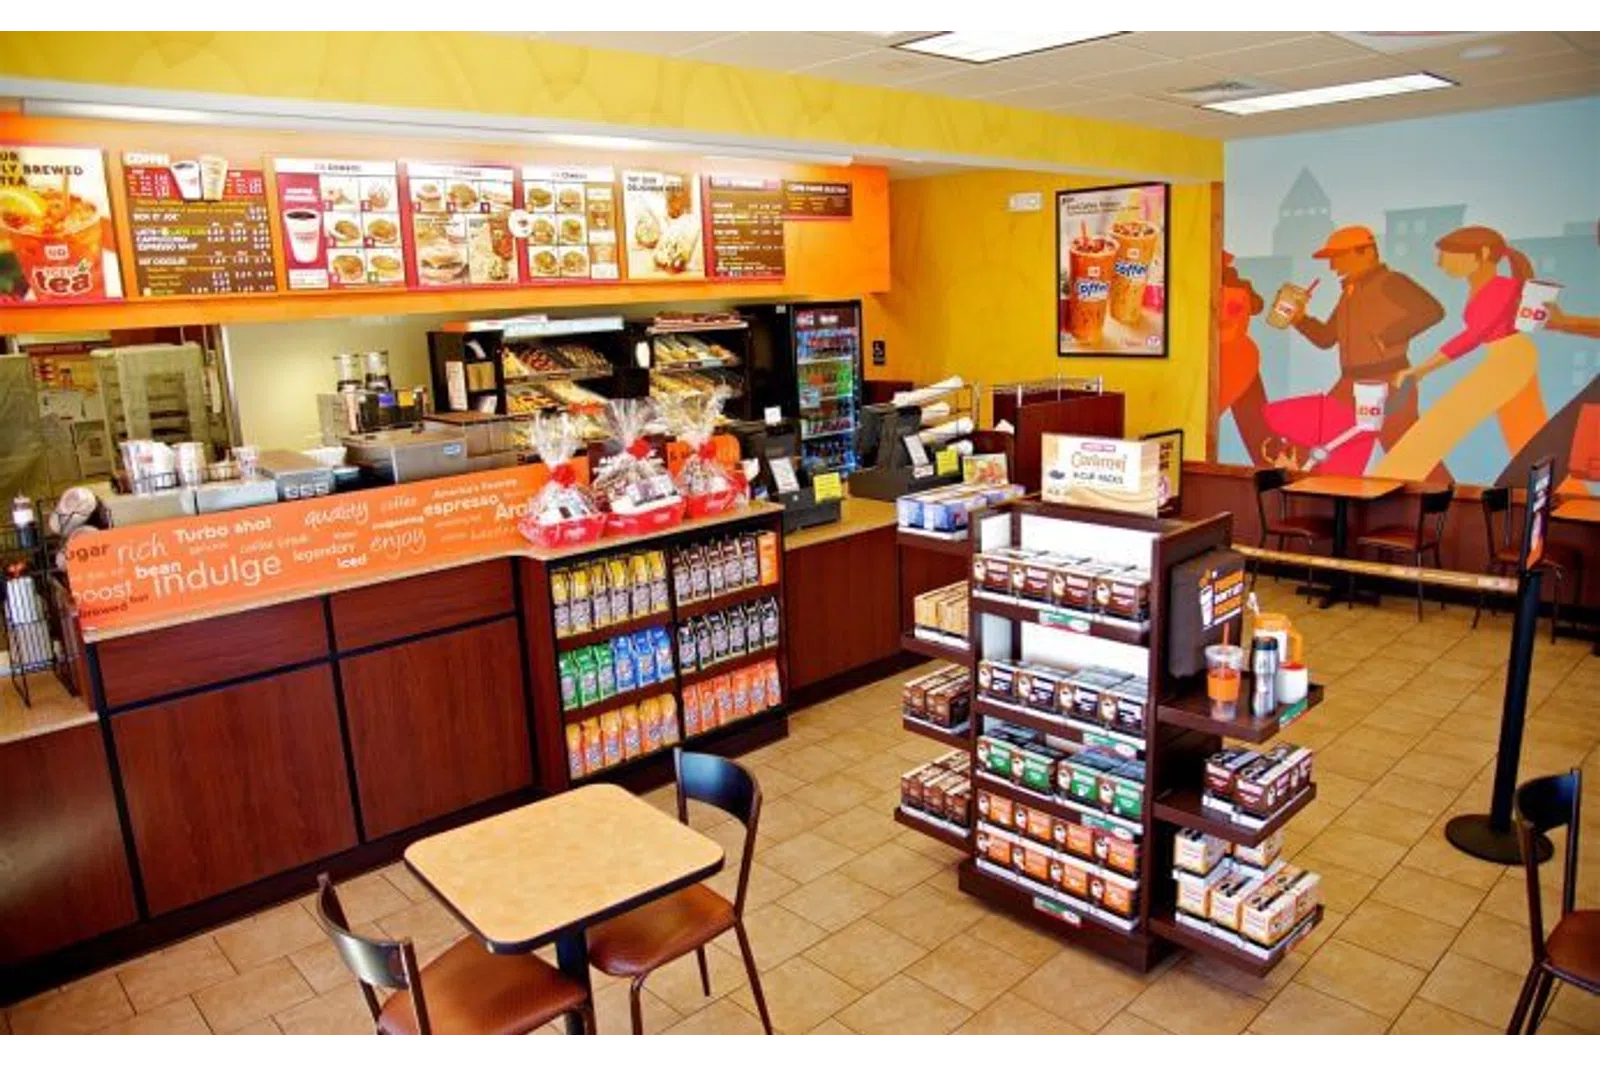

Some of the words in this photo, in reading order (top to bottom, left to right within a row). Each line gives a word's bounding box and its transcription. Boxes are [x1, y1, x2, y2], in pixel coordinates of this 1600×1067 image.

[23, 164, 84, 175] BREWED
[35, 270, 90, 294] tea
[1519, 307, 1547, 321] DD
[304, 500, 369, 532] quality
[423, 495, 500, 517] espresso
[173, 527, 230, 545] Turbo
[233, 516, 273, 535] shot
[117, 532, 169, 566] rich
[369, 527, 427, 560] enjoy
[135, 562, 182, 580] bean
